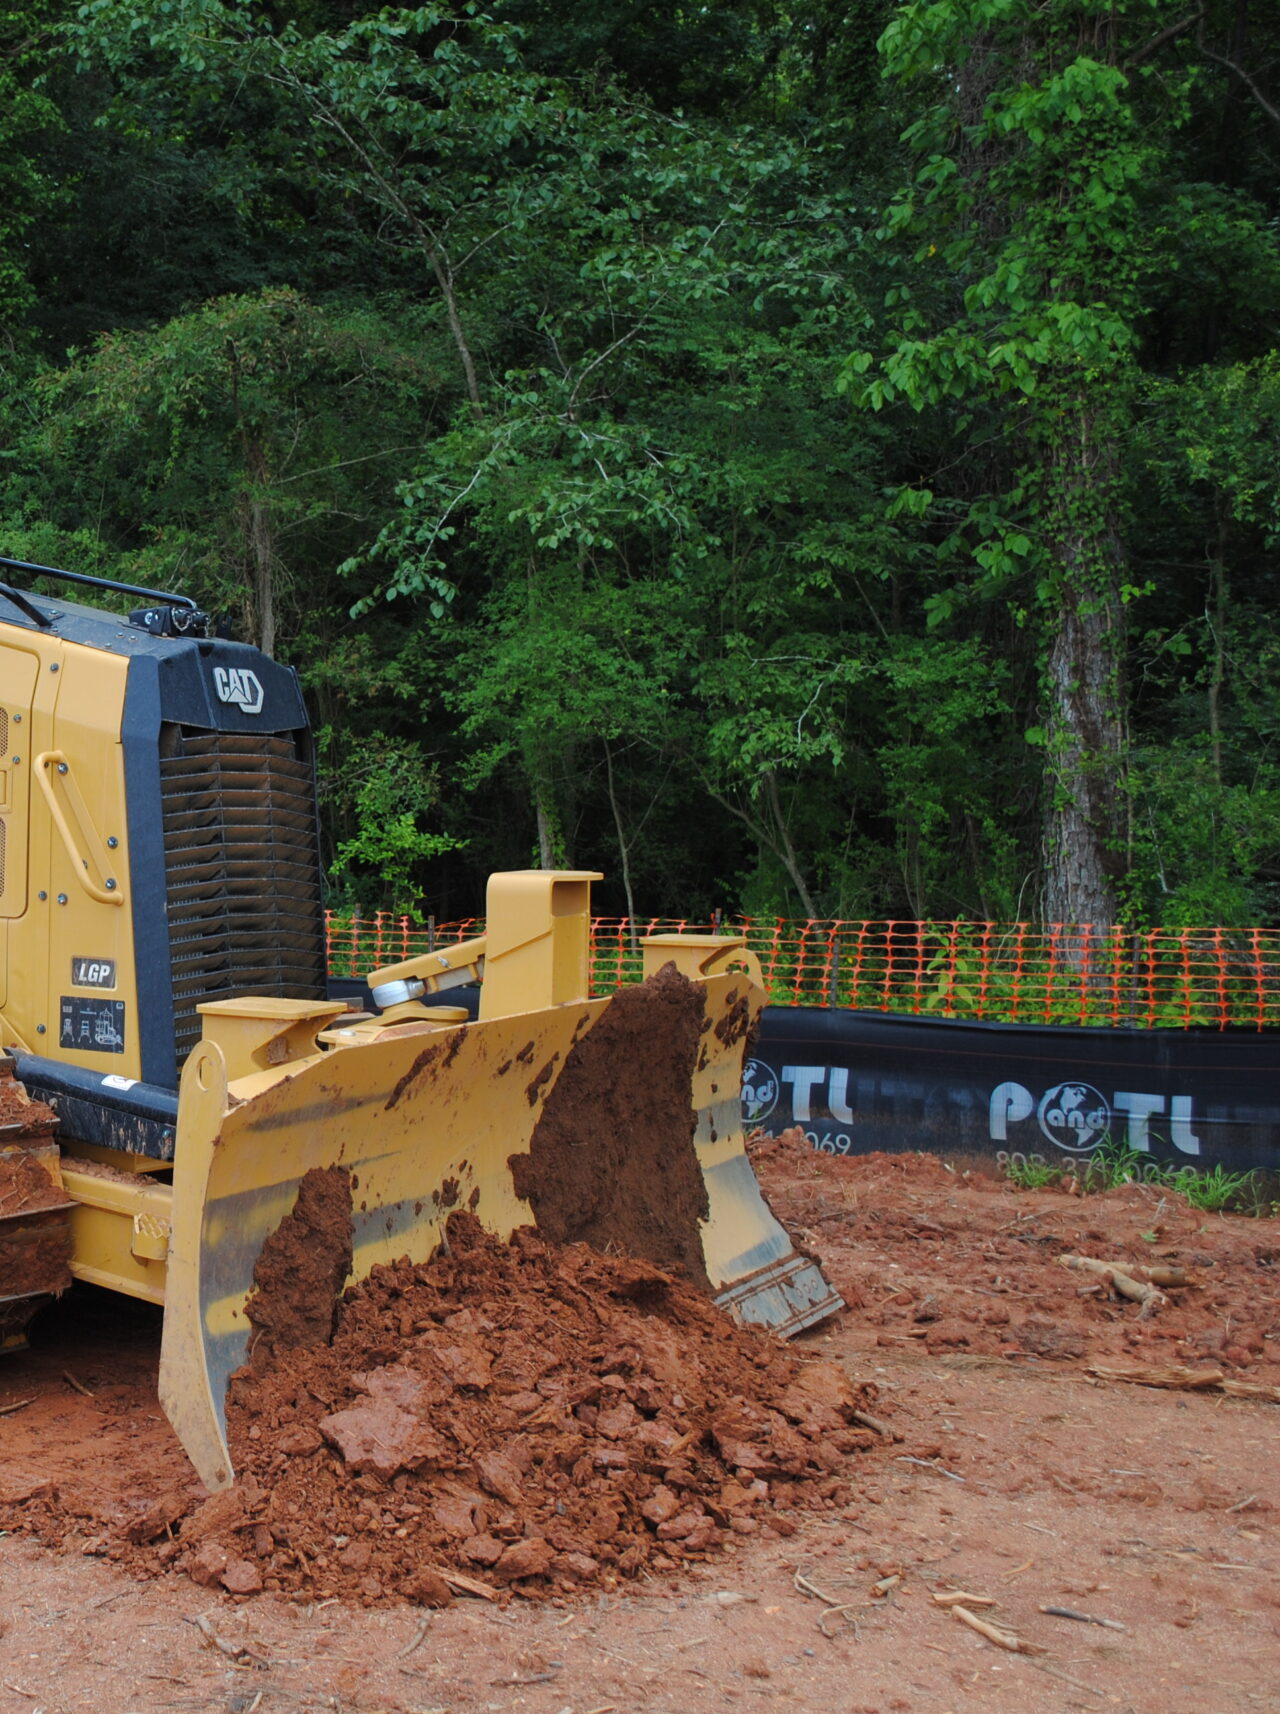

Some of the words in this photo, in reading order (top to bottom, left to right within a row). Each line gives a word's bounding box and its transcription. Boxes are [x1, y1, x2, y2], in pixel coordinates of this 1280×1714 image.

[213, 666, 253, 703] CAT
[78, 963, 111, 983] LGP
[741, 1080, 774, 1103] nd
[1046, 1106, 1106, 1130] and
